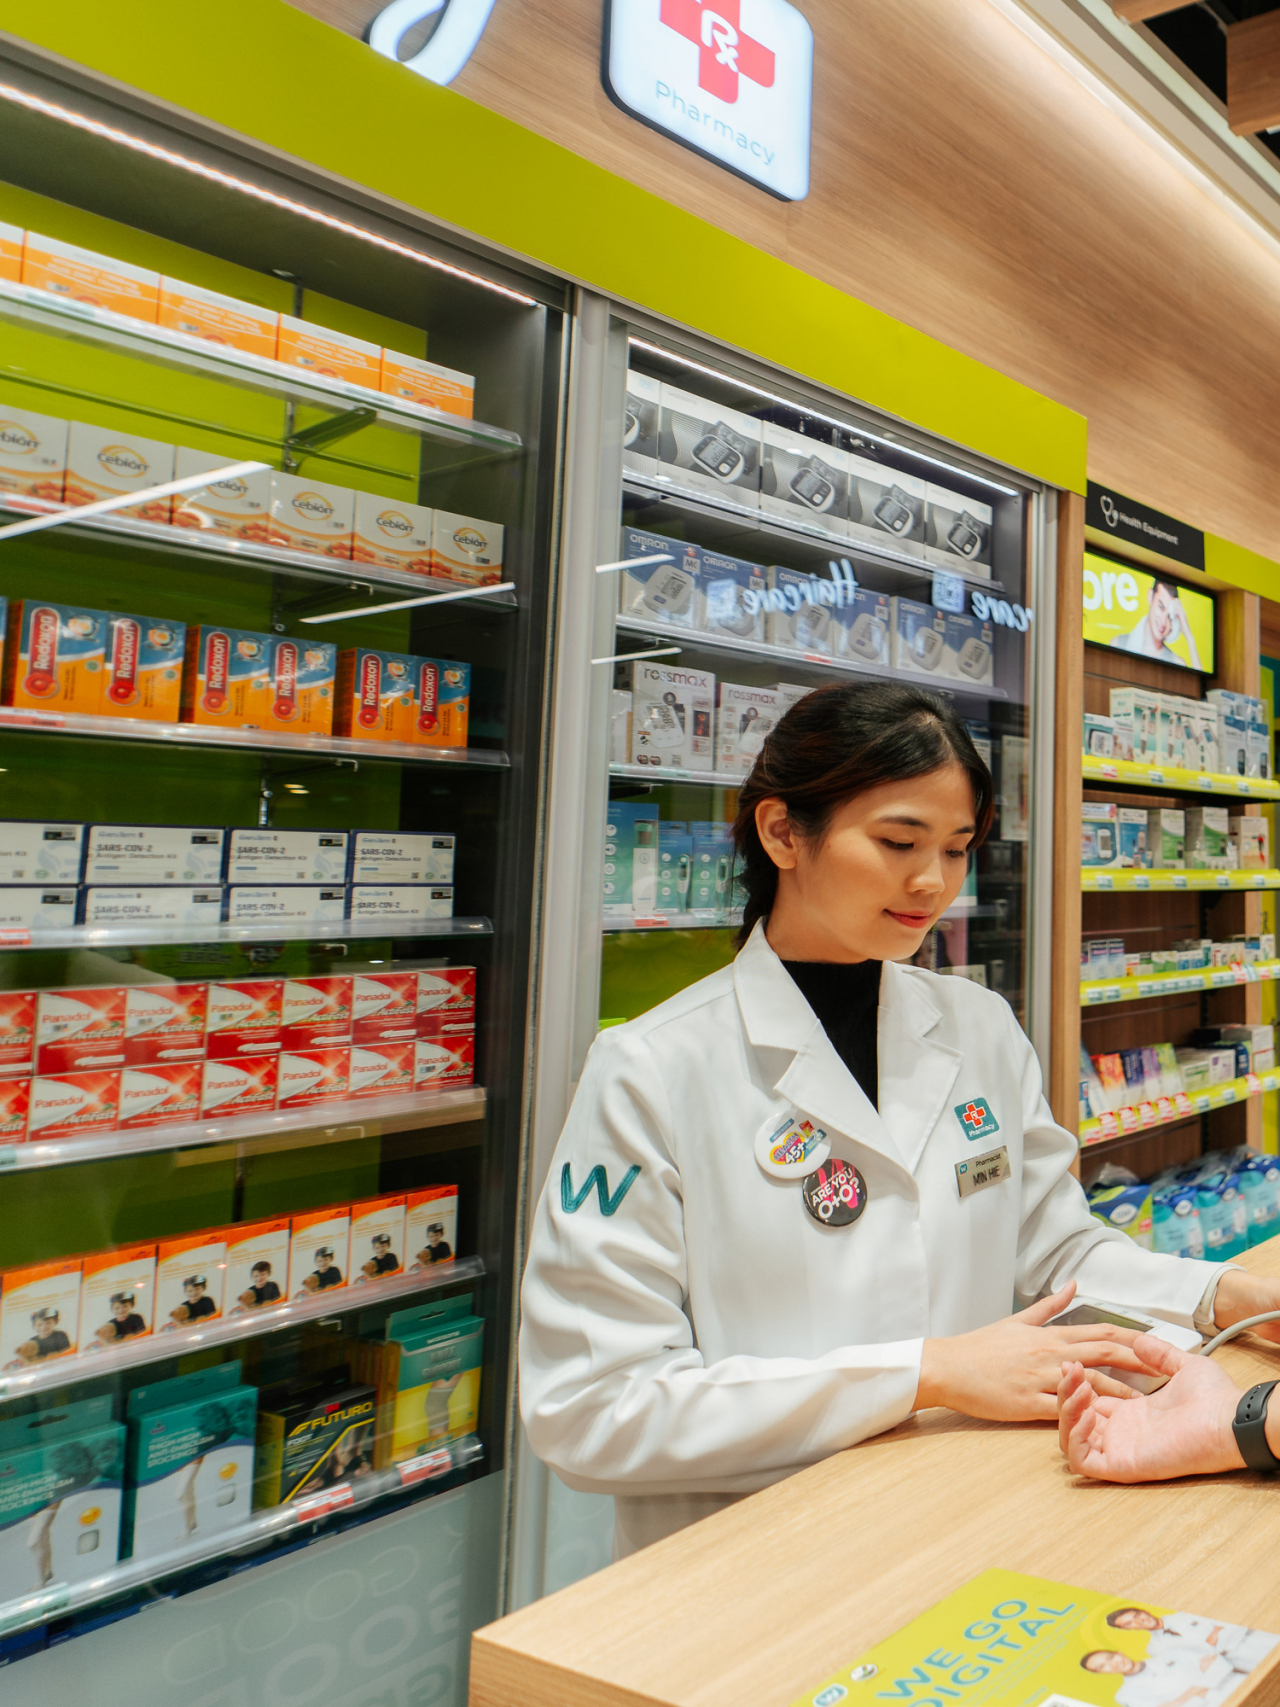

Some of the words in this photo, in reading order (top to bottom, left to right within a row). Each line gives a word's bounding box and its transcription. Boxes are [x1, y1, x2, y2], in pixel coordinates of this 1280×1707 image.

[655, 79, 775, 166] Pharmacy
[1118, 512, 1143, 530] Health
[1142, 521, 1179, 546] Equipment
[629, 533, 669, 550] OMRON
[703, 555, 737, 571] OMRON
[33, 614, 55, 670] Redoxon
[116, 623, 135, 678] Redoxon
[209, 638, 226, 688] Redoxon
[278, 648, 293, 697] Redoxon
[644, 667, 707, 688] rossmax
[364, 659, 378, 706] Redoxon
[423, 667, 436, 712] Redoxon
[728, 690, 776, 706] rossmax
[355, 992, 392, 1002] Panadol
[418, 987, 451, 997] Panadol
[211, 1002, 252, 1013] Panadol
[285, 997, 324, 1007] Panadol
[42, 1012, 91, 1023] Panadol
[128, 1007, 174, 1017] Panadol
[353, 1062, 388, 1073] Panadol
[417, 1054, 450, 1065] Panadol
[283, 1069, 321, 1081] Panadol
[207, 1077, 248, 1090] Panadol
[124, 1087, 169, 1099] Panadol
[35, 1095, 84, 1109] Panadol
[968, 1123, 995, 1138] Pharmacy
[772, 1132, 800, 1161] HEALTH
[784, 1142, 806, 1165] 45+
[975, 1153, 1002, 1167] Pharmacist
[560, 1161, 642, 1217] W
[811, 1184, 833, 1207] ARE
[832, 1167, 853, 1189] YOU
[310, 1401, 373, 1430] FUTURO
[875, 1647, 965, 1698] WE
[963, 1599, 1028, 1641] GO
